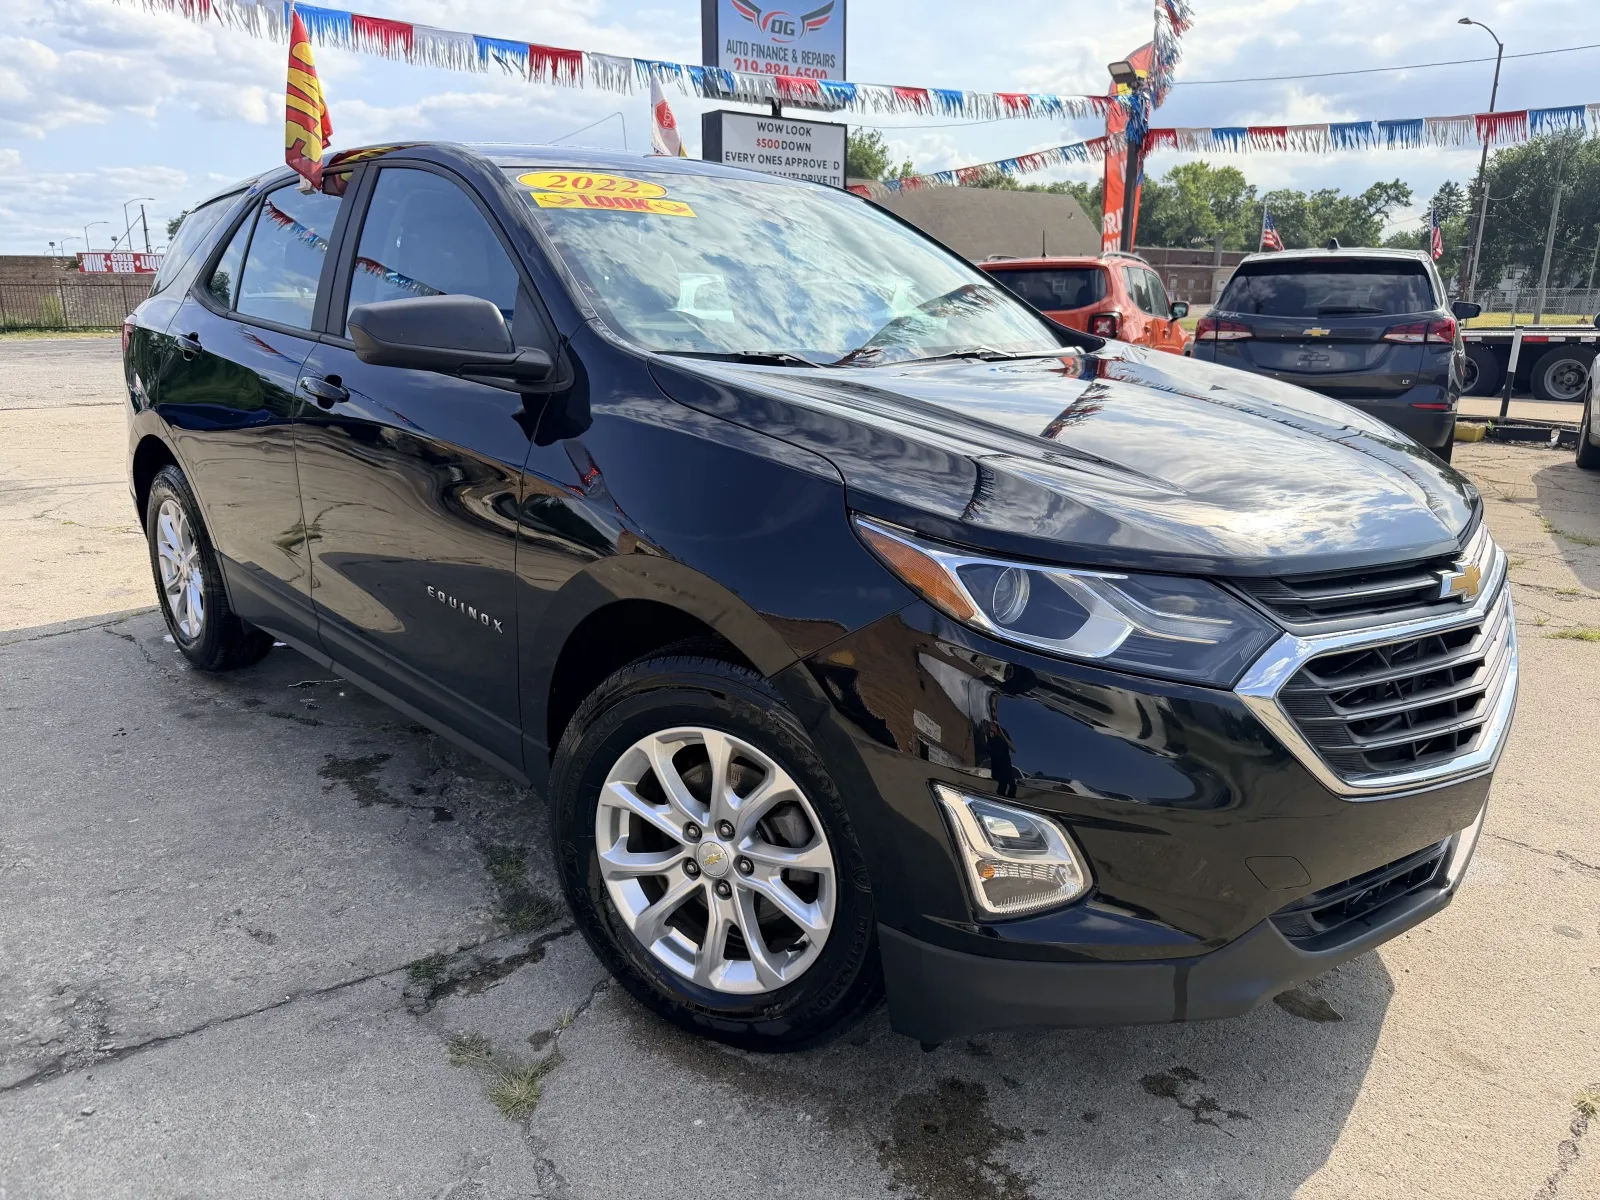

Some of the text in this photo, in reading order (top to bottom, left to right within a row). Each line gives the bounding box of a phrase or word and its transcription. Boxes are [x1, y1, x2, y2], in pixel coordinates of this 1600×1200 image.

[770, 19, 795, 37] OG
[726, 39, 836, 68] AUTO FINANCE & REPAIRS
[757, 121, 812, 137] WOW LOOK
[756, 138, 811, 152] $500 DOWN
[725, 151, 756, 163] EVERY
[757, 154, 783, 166] ONES
[546, 174, 640, 193] 2022
[578, 194, 654, 212] LOOK
[82, 253, 107, 272] WINE
[110, 253, 134, 262] COLD
[112, 261, 136, 273] BEER
[427, 585, 503, 634] EQUINOX
